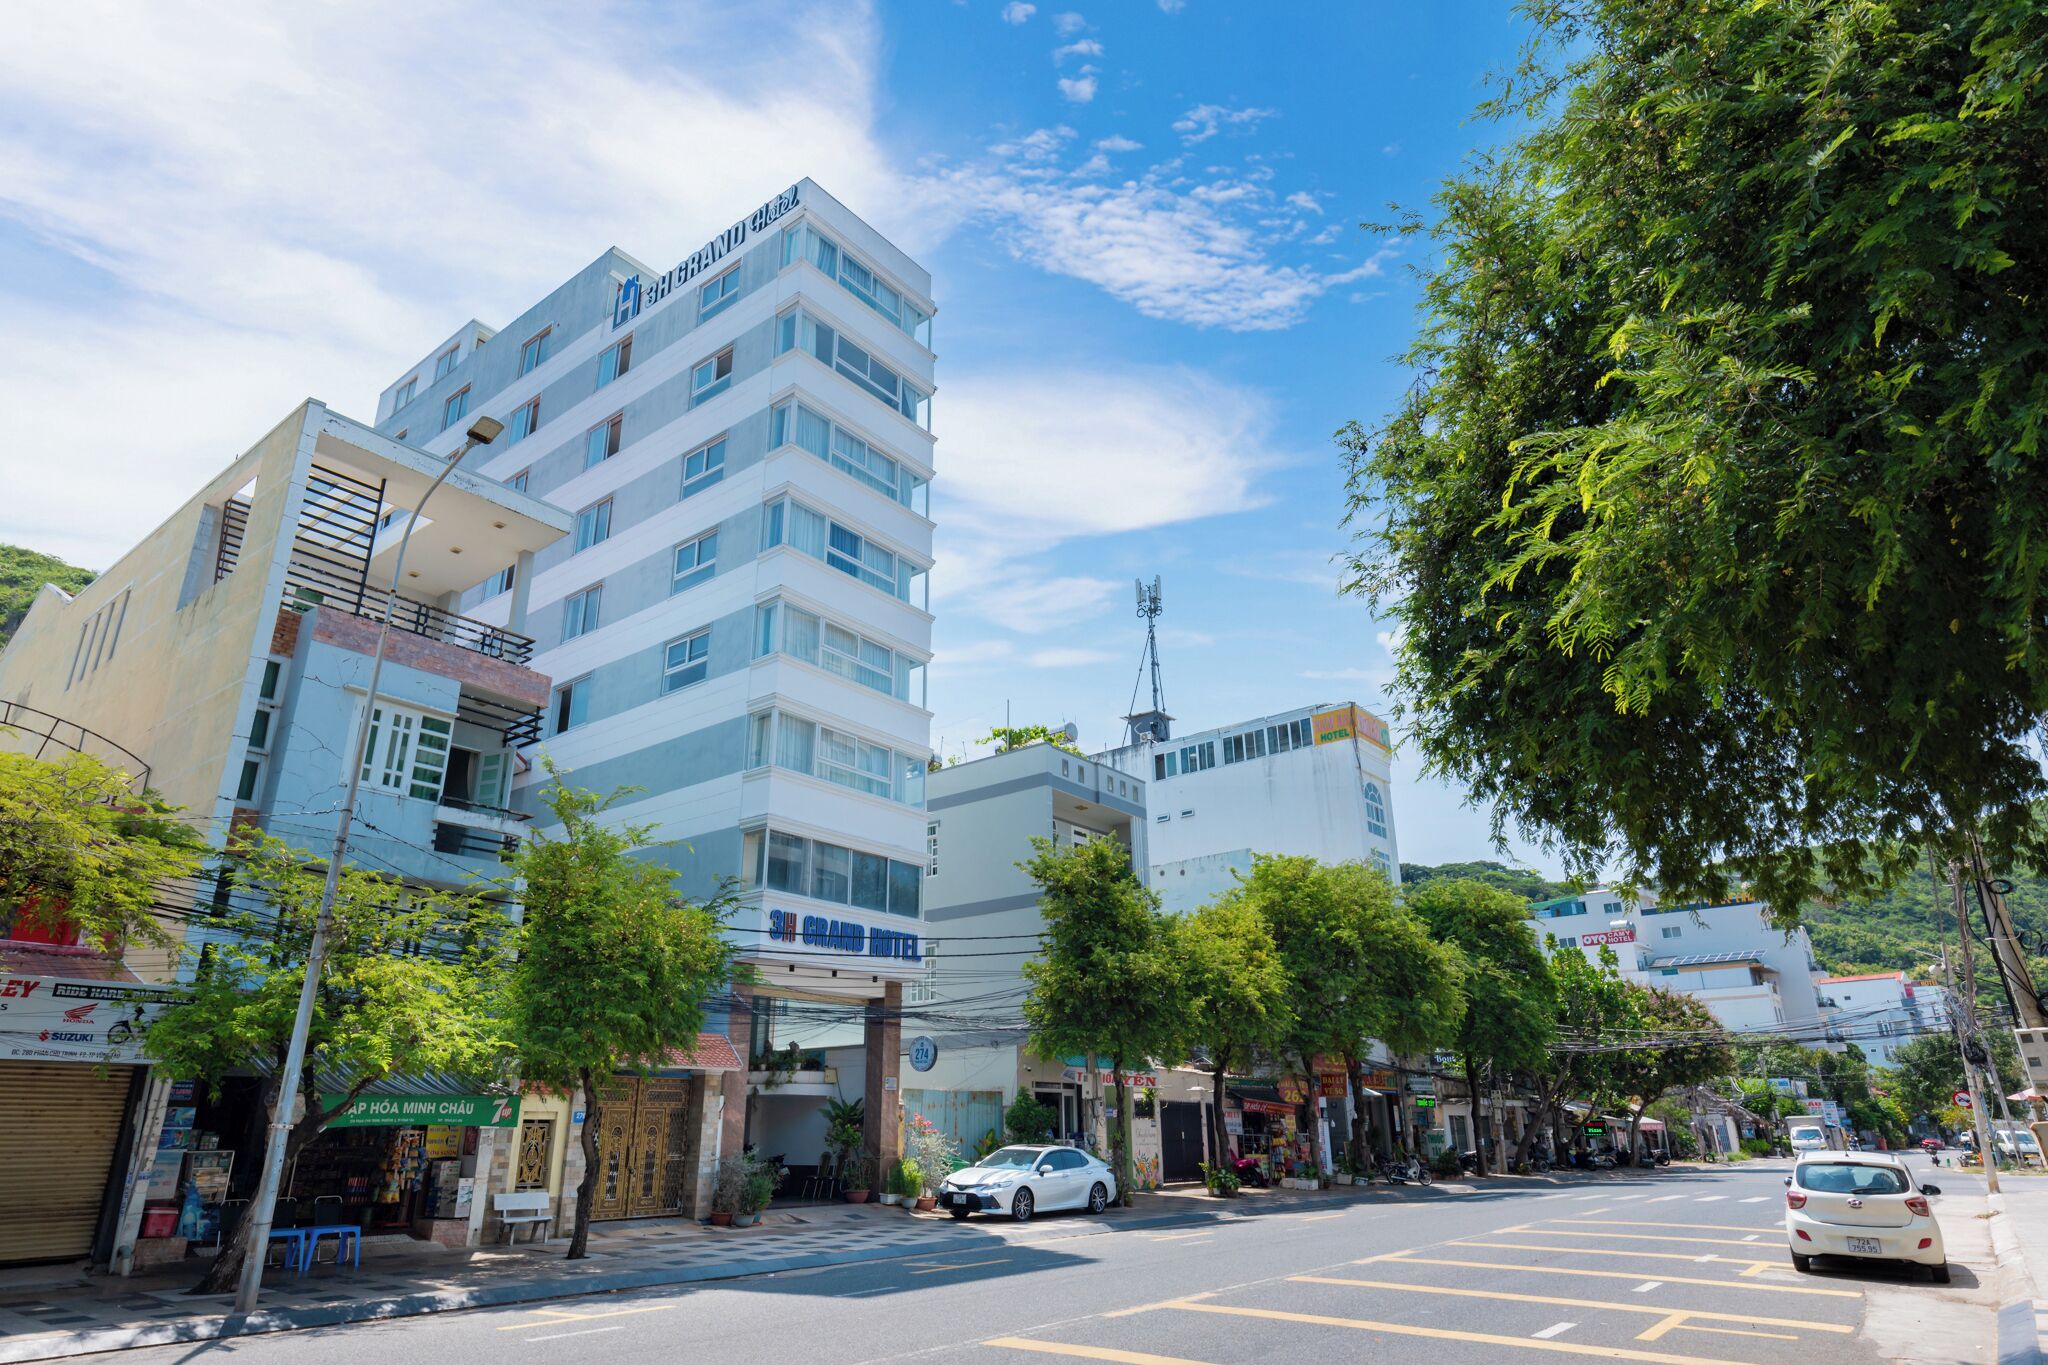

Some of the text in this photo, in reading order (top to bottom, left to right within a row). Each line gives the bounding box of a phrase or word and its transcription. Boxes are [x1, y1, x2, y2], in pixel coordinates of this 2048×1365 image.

[646, 185, 800, 308] 3H GRAND Hotel
[1320, 729, 1350, 743] HOTEL
[770, 909, 922, 962] 3H GRAND HOTEL
[1583, 930, 1630, 945] OYO CAMY
[1608, 936, 1633, 944] HOTEL
[0, 979, 40, 998] EY
[56, 985, 88, 997] RIDE
[52, 1032, 93, 1042] SUZUKI
[915, 1048, 929, 1060] 274
[343, 1098, 474, 1118] ẠP HÓA MINH CHÂU
